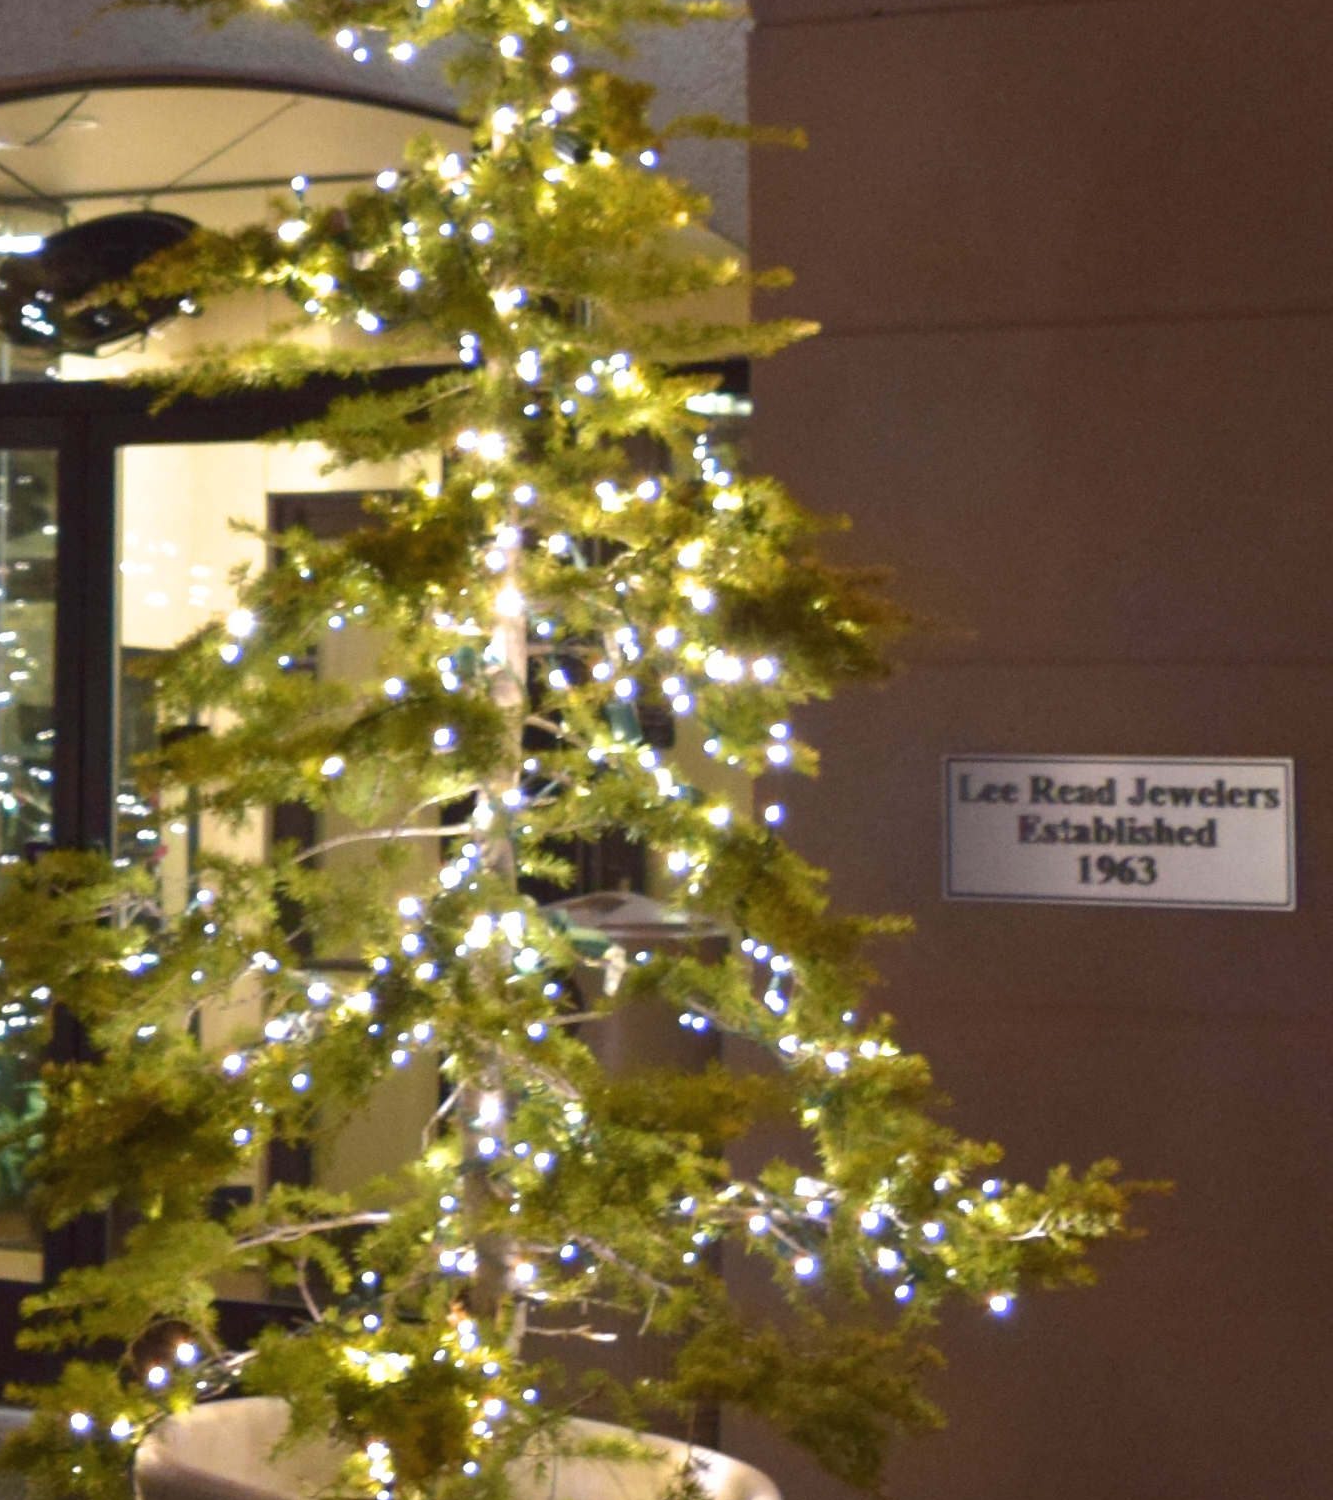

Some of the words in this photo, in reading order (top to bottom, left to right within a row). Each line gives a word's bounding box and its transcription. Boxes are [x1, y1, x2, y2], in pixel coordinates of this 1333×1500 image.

[957, 773, 1020, 803] Lee
[1030, 775, 1117, 806] Read
[1127, 777, 1281, 809] Jewelers
[1017, 814, 1218, 847] Established
[1077, 854, 1159, 885] 1963
